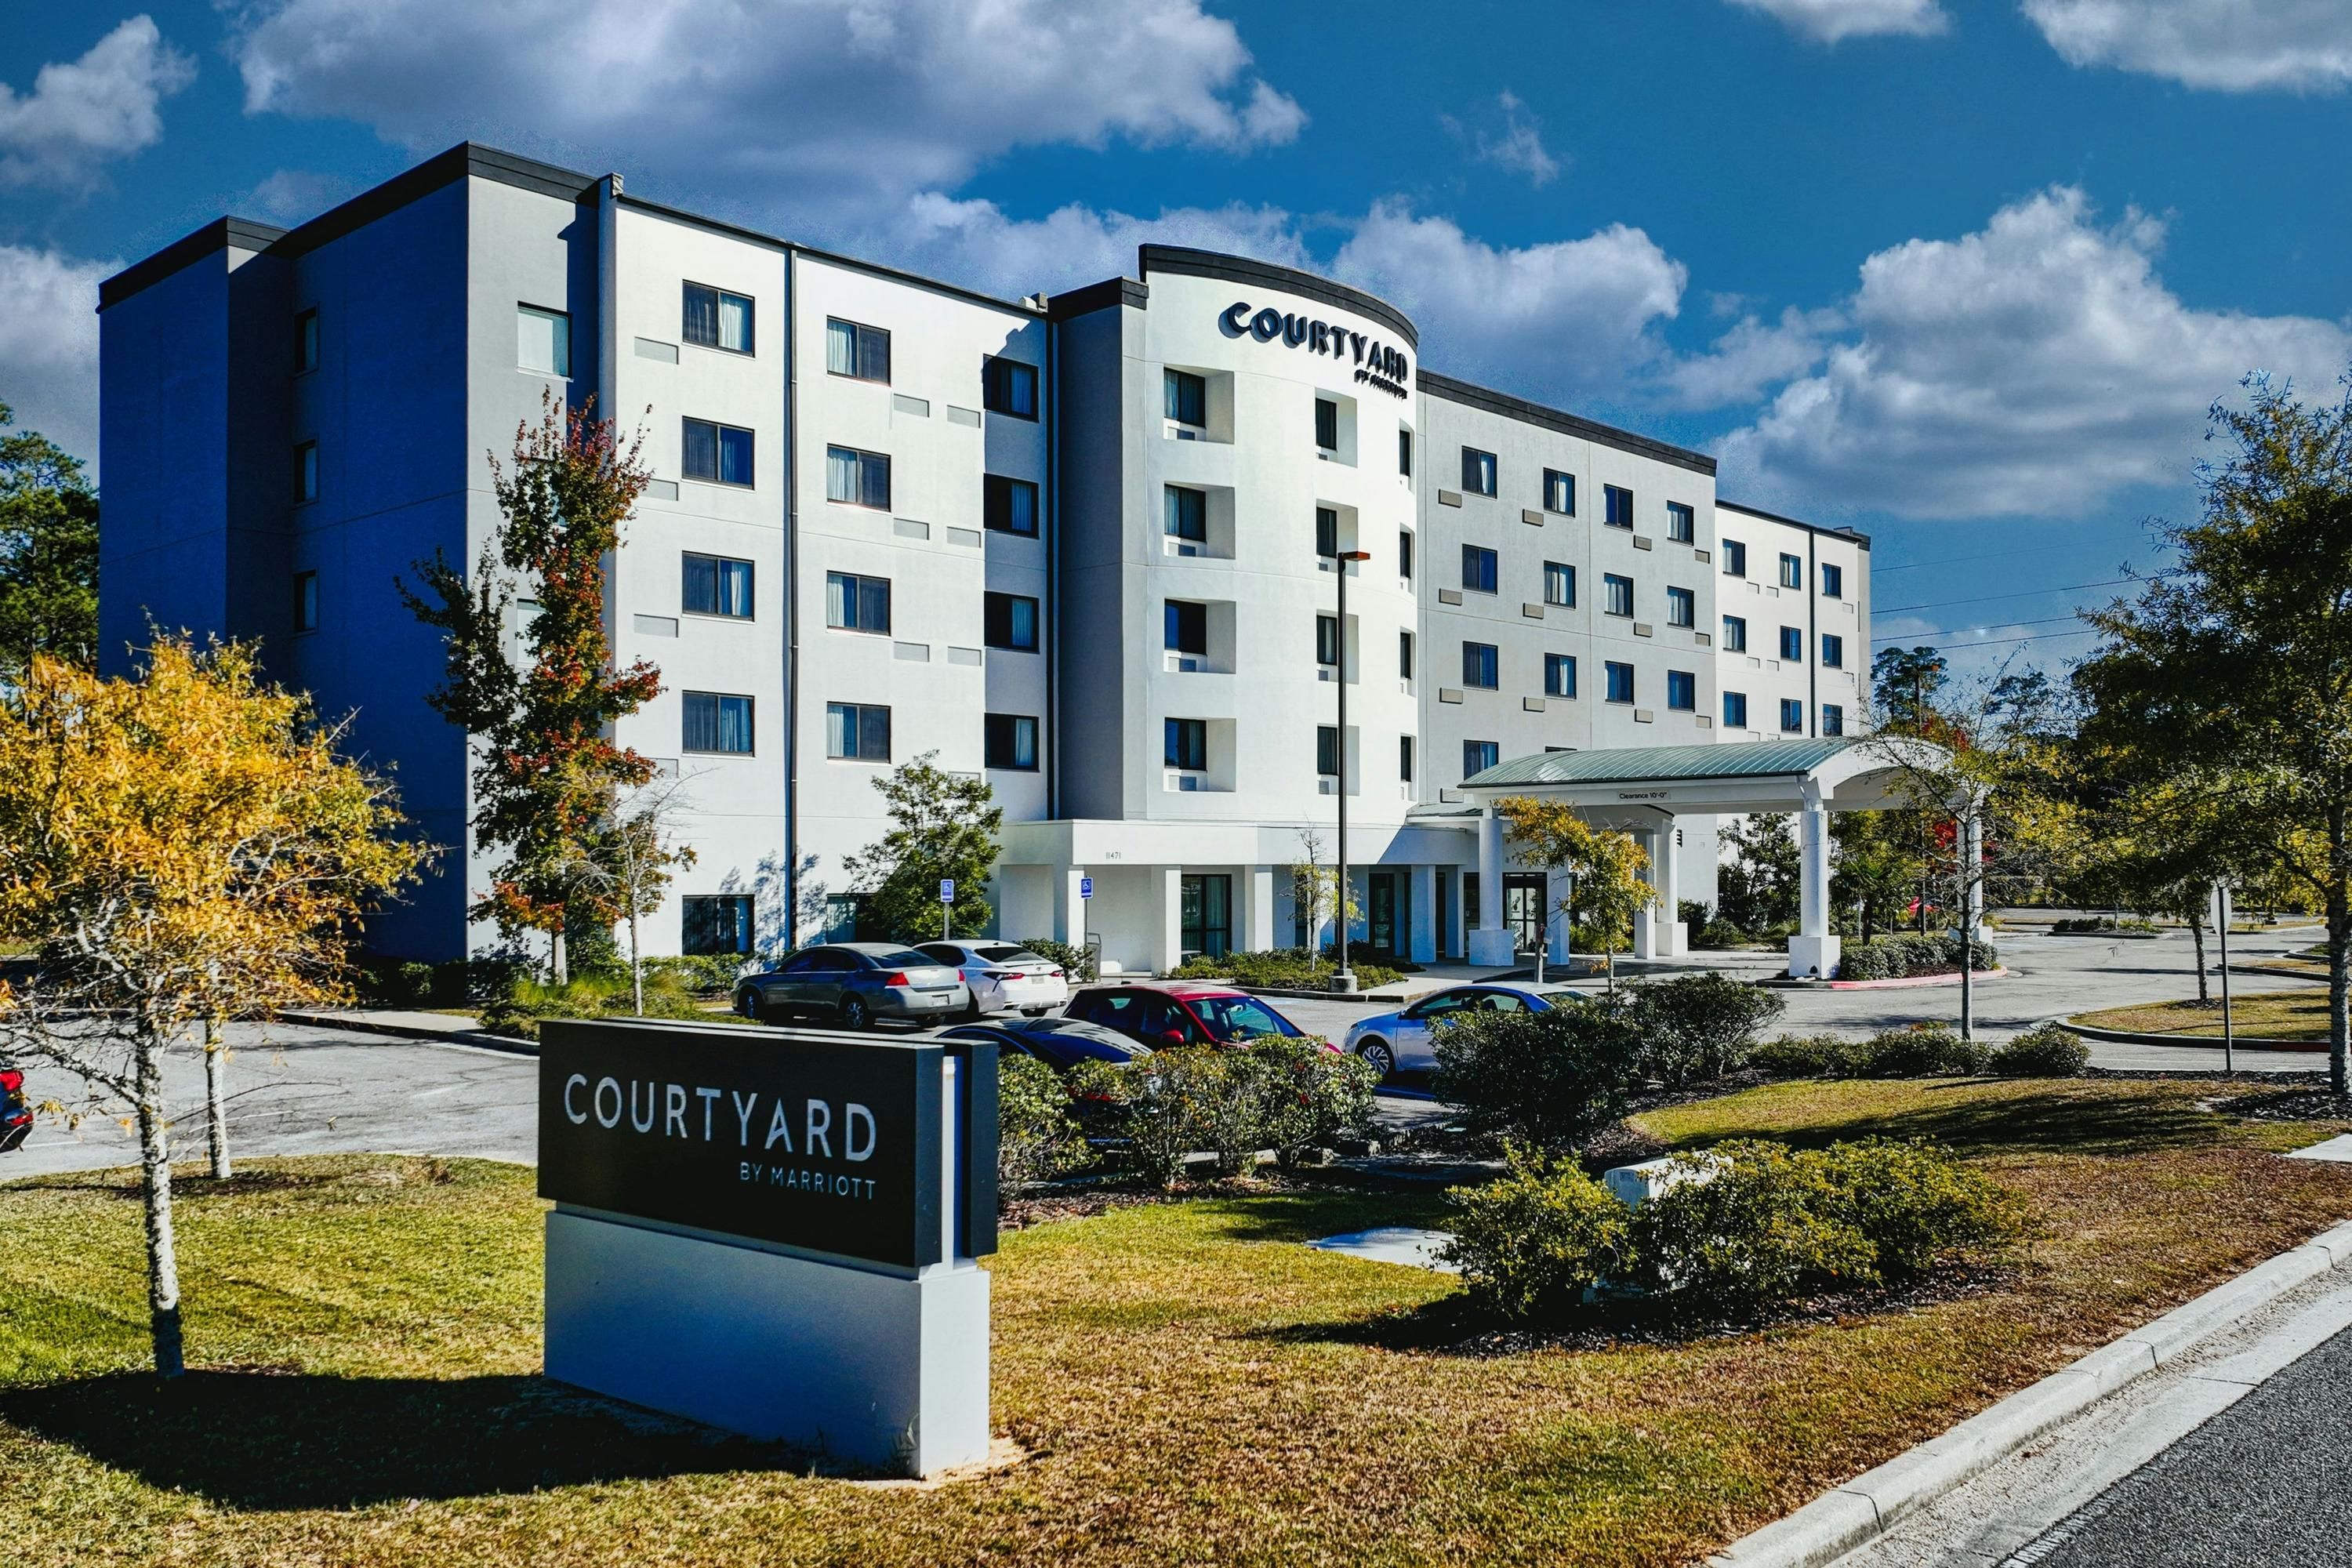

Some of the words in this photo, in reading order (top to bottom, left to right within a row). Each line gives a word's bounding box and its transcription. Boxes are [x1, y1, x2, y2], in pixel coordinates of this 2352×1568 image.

[1218, 301, 1408, 384] COURTYARD
[1105, 851, 1121, 860] 11471
[564, 1073, 877, 1162] COURTYARD
[739, 1161, 762, 1181] BY
[770, 1166, 876, 1200] MARRIOTT
